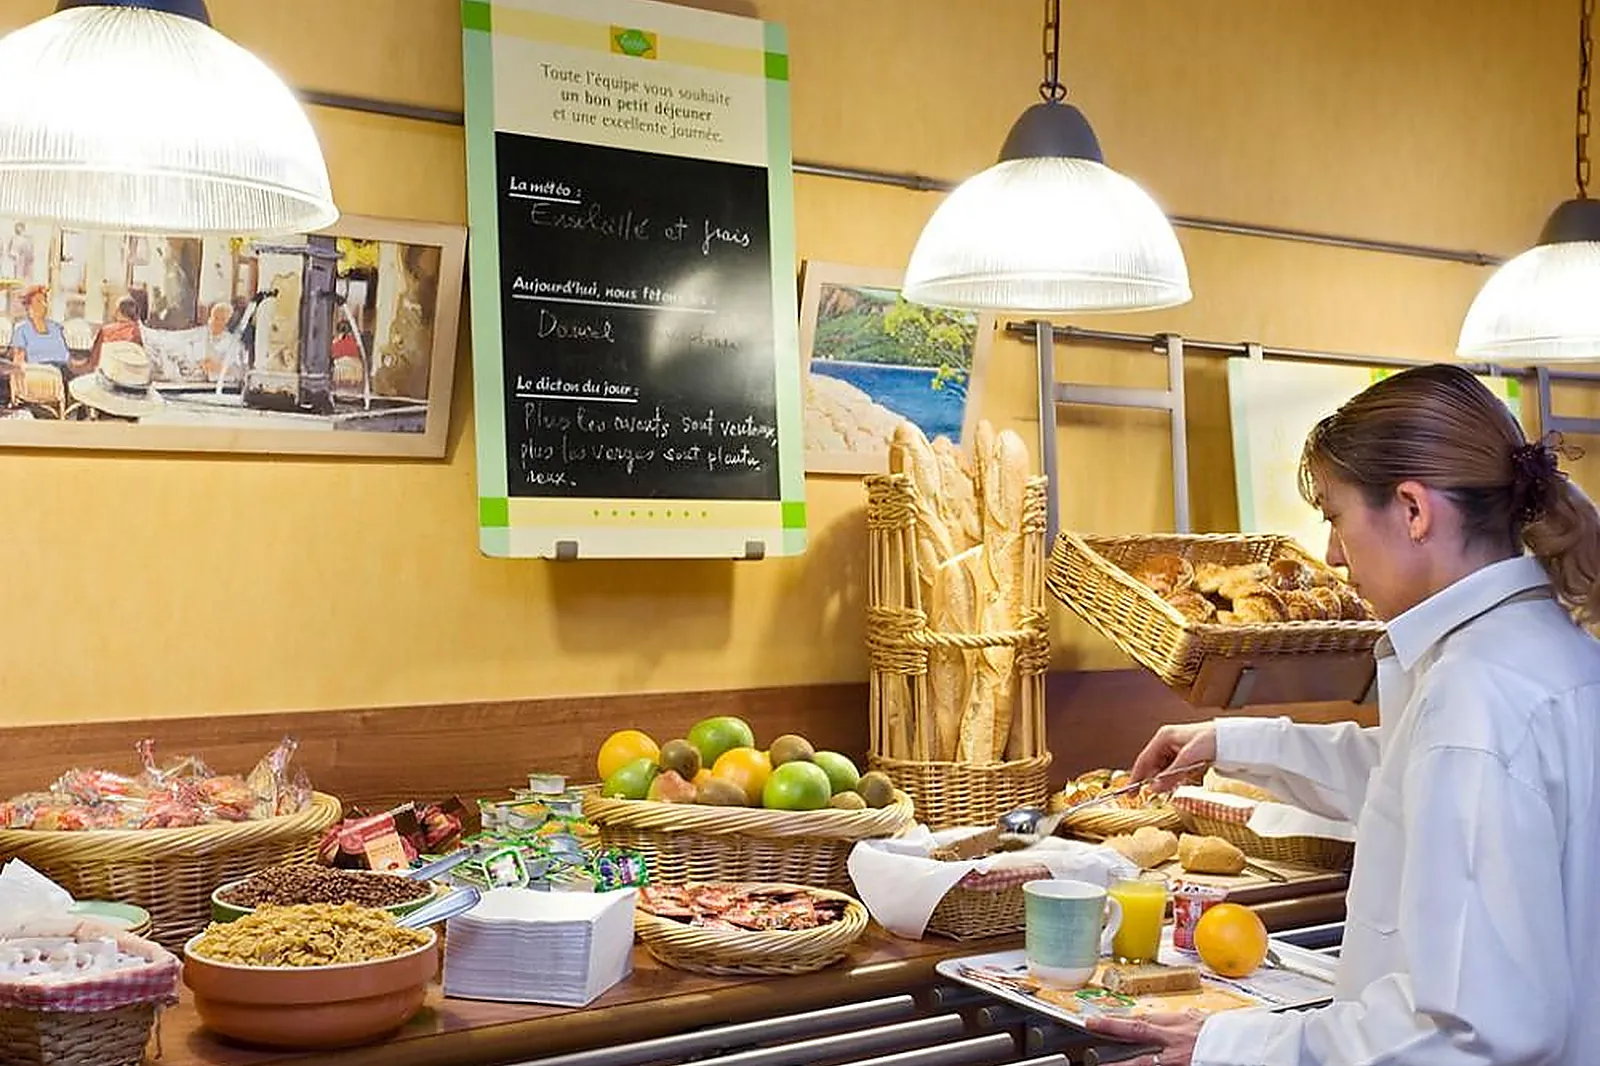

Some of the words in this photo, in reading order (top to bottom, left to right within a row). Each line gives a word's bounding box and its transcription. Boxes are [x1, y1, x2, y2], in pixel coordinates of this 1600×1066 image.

[540, 63, 581, 83] Toute
[586, 70, 639, 93] l'équipe
[643, 83, 673, 97] vous
[678, 88, 730, 106] souhaite
[561, 90, 579, 102] un
[585, 90, 611, 107] bon
[617, 98, 648, 112] petit
[655, 101, 712, 121] déjeuner
[553, 109, 566, 120] et
[572, 112, 596, 125] une
[602, 116, 667, 135] excellente
[510, 176, 527, 191] La
[664, 215, 688, 241] et
[512, 276, 601, 299] Aujourd'hui,
[605, 287, 637, 299] nous
[516, 375, 532, 390] Le
[536, 376, 579, 392] dicton
[582, 379, 600, 393] du
[603, 380, 631, 396] jour
[525, 402, 571, 432] Plus
[521, 437, 553, 469] plus
